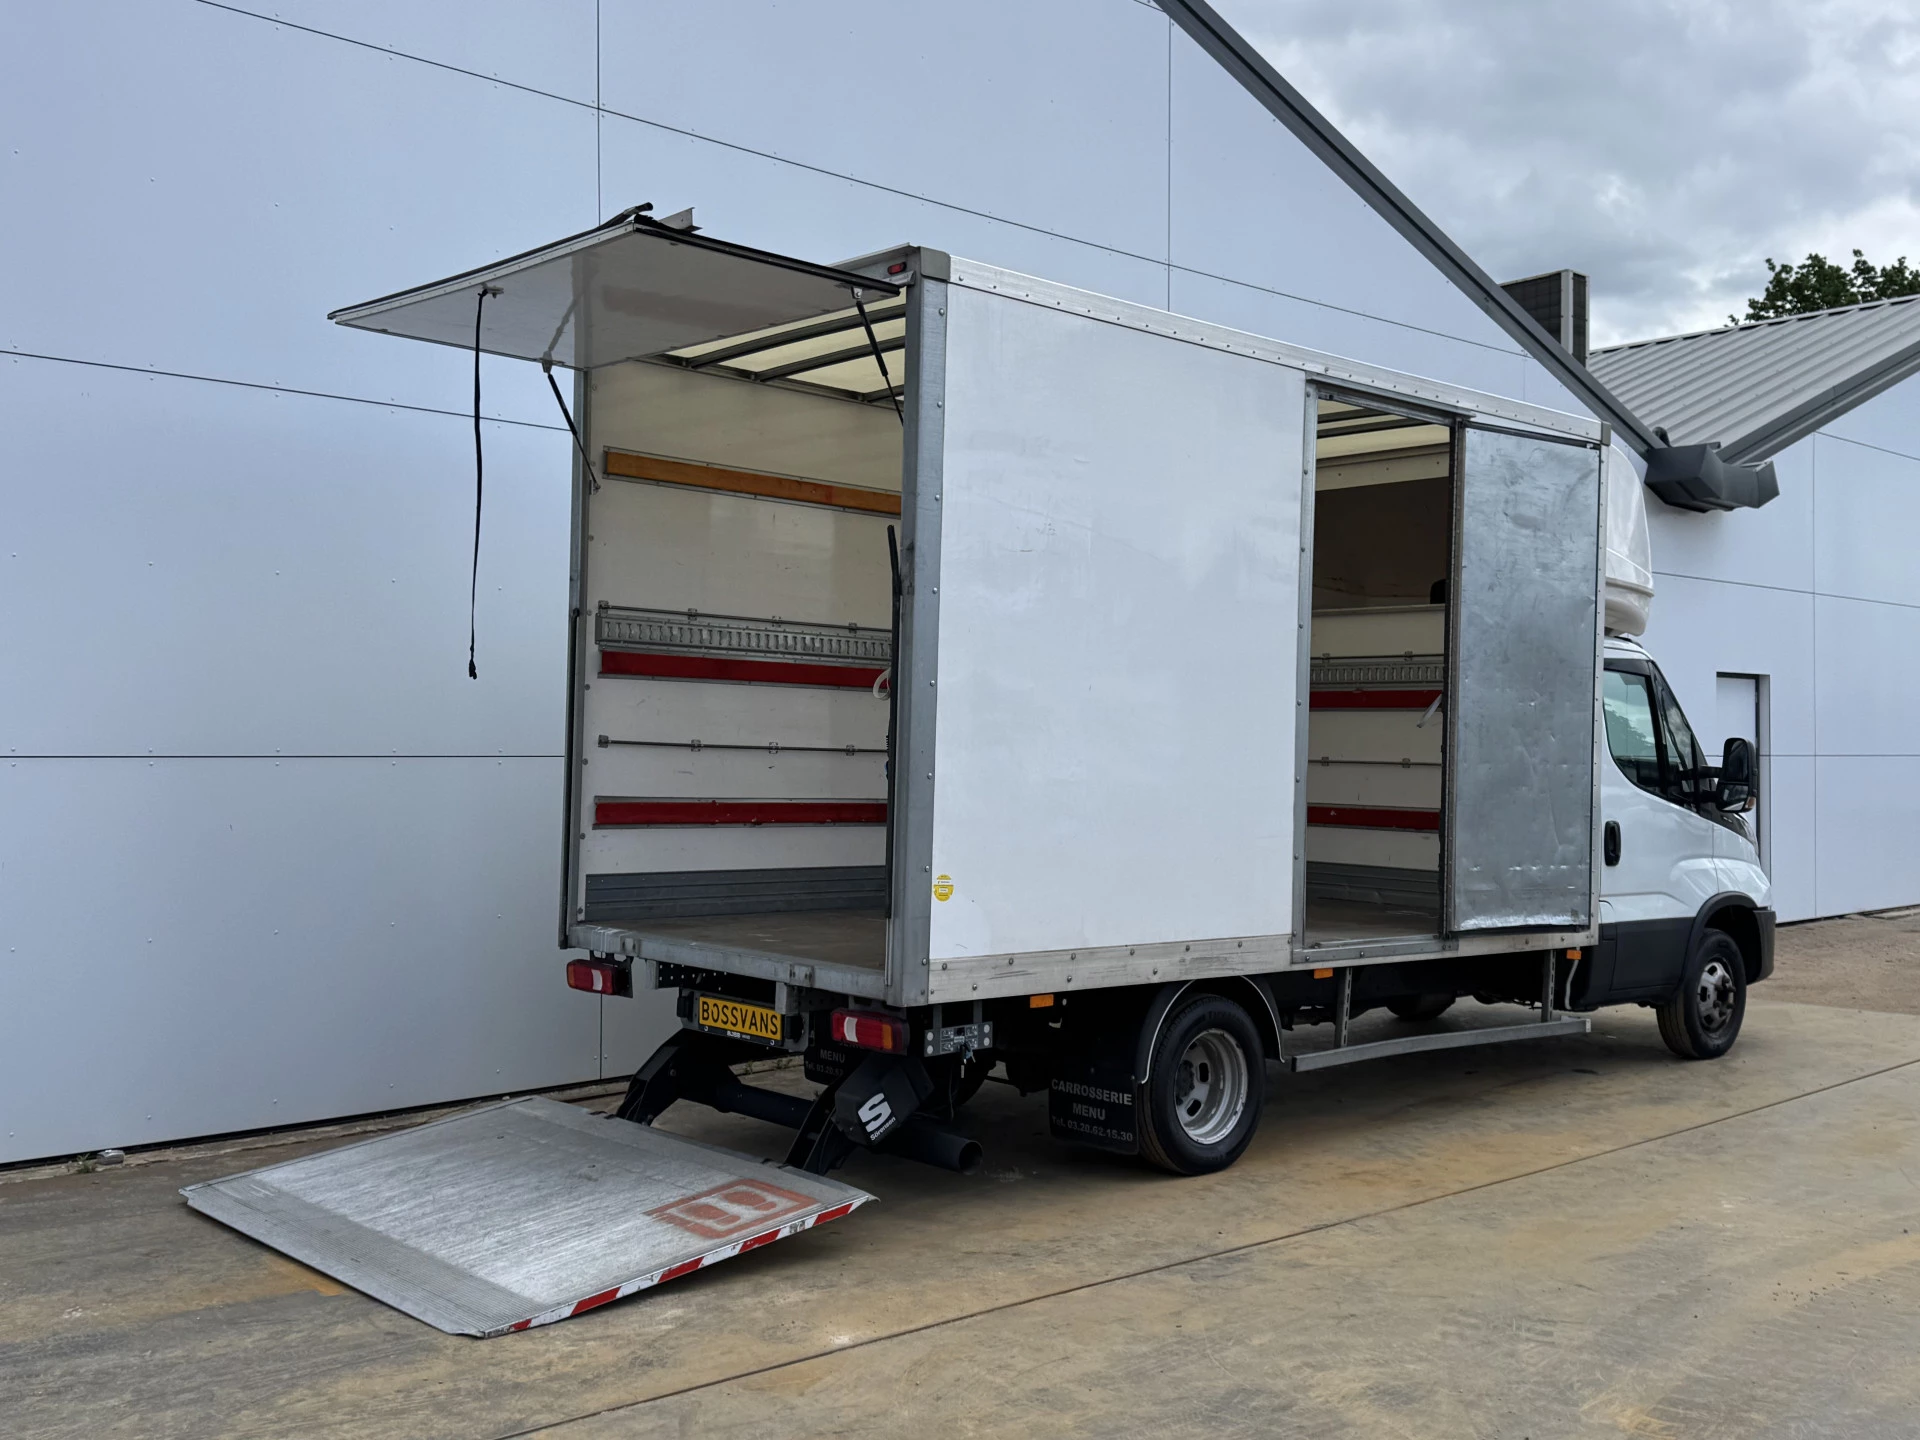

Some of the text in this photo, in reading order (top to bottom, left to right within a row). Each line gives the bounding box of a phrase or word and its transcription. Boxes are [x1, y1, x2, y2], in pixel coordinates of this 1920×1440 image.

[702, 1000, 778, 1035] BOSSVANS
[820, 1048, 846, 1064] MENU
[1051, 1078, 1133, 1106] CARROSSERIE
[1072, 1102, 1106, 1121] MENU
